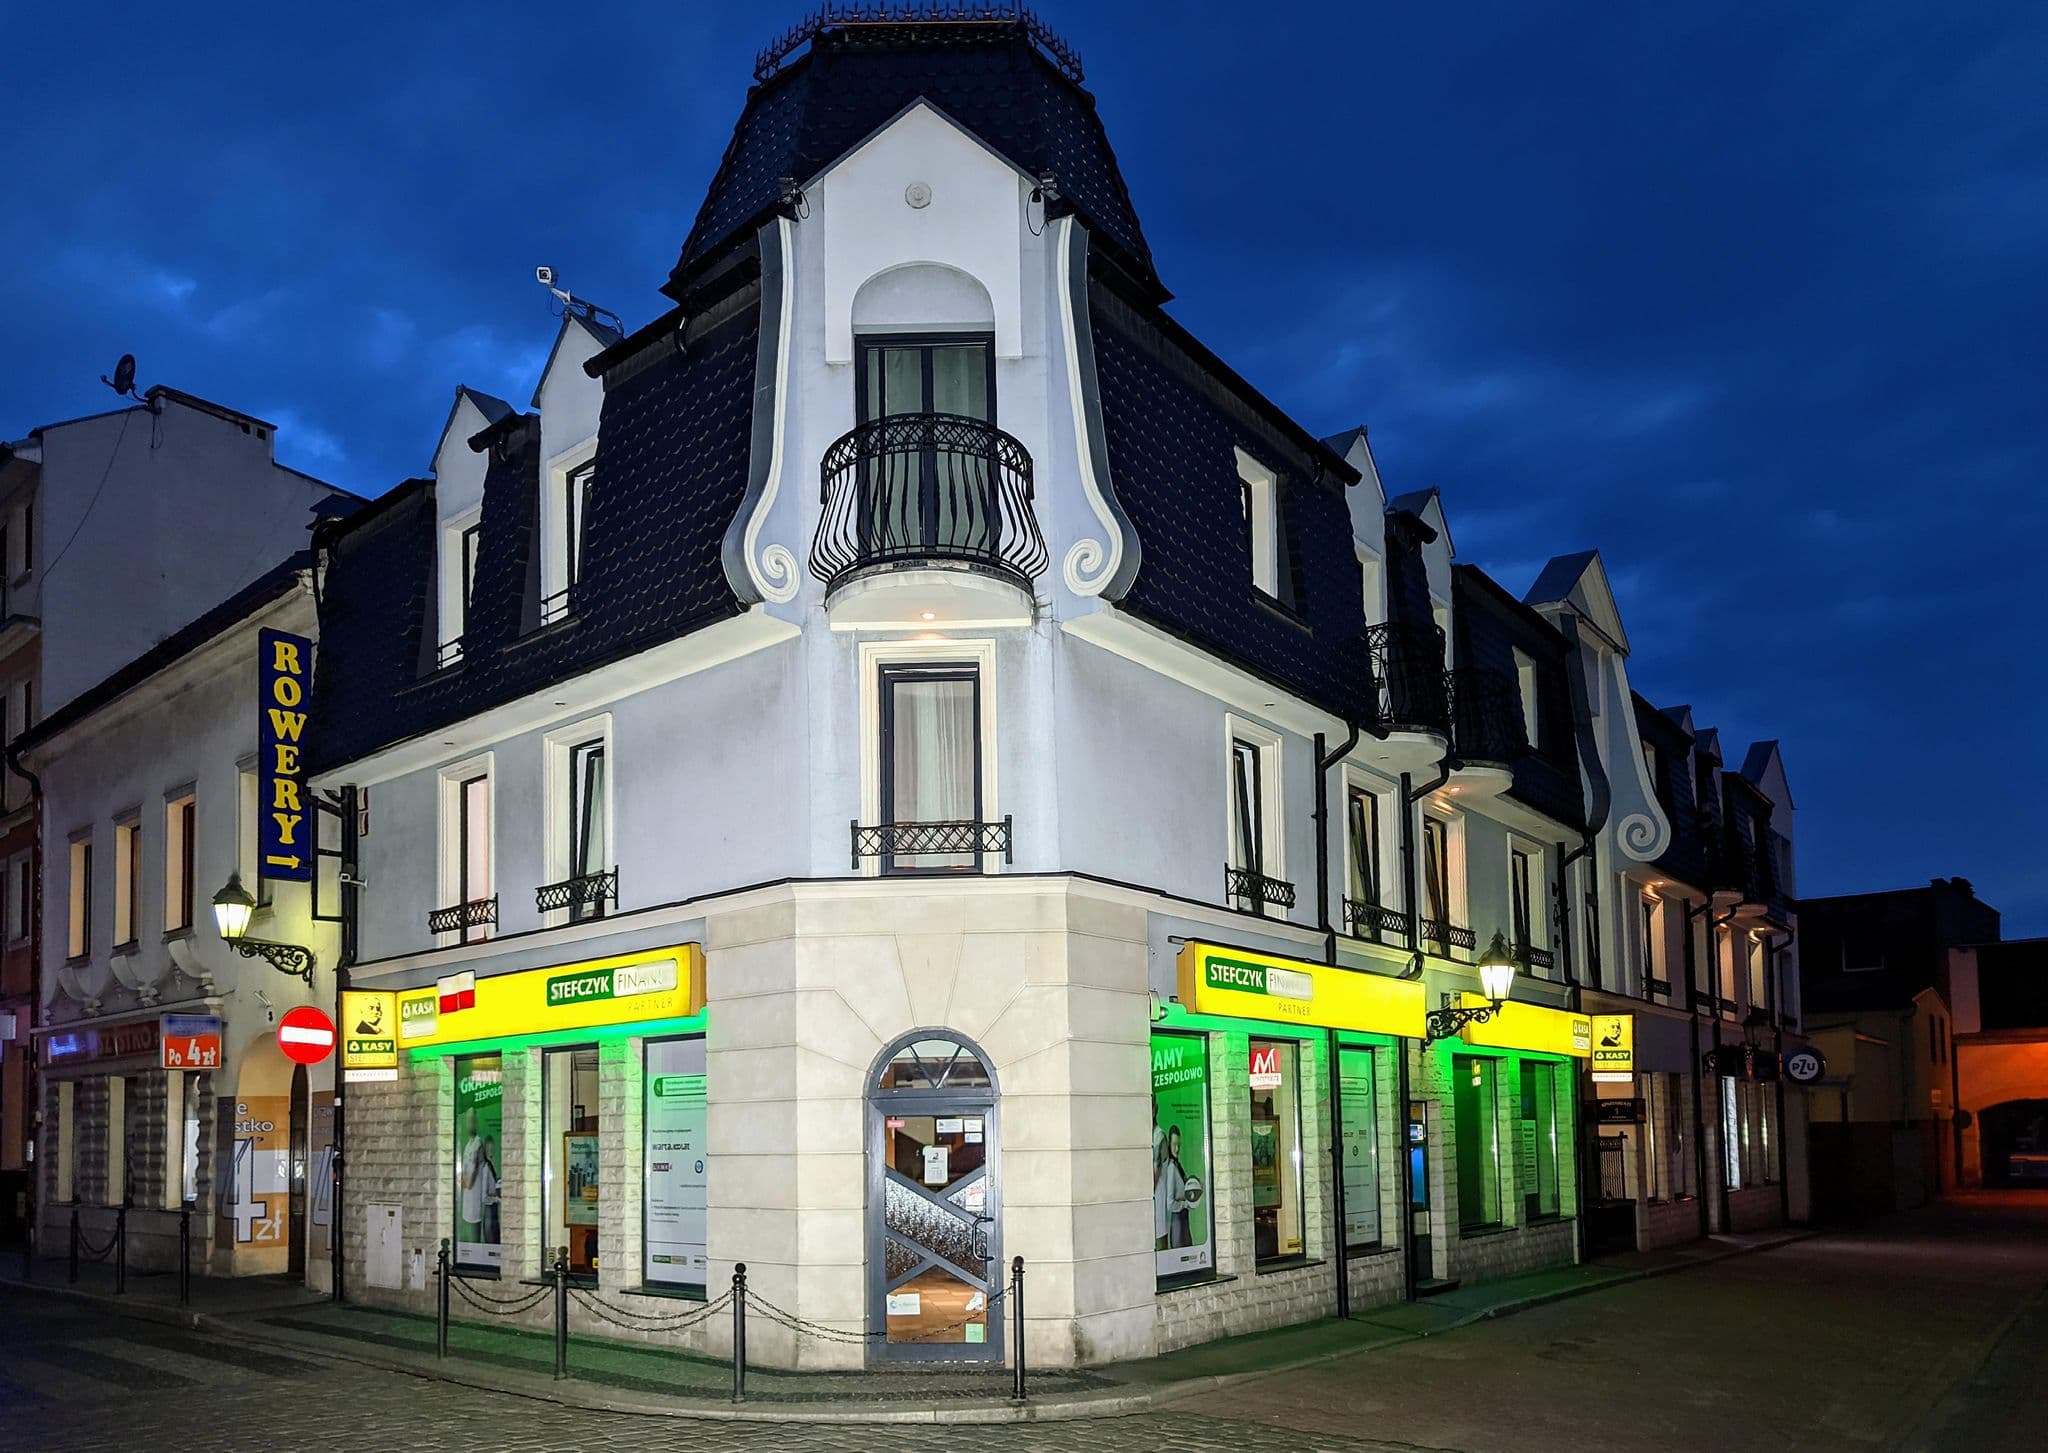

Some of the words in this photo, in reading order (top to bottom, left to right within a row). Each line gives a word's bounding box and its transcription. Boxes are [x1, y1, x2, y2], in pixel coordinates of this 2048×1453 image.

[268, 640, 307, 845] ROWERY
[1210, 963, 1264, 988] STEFCZYK
[551, 976, 610, 1001] STEFCZYK
[411, 1001, 435, 1017] KASA
[626, 997, 673, 1011] PARTNER
[1278, 1002, 1312, 1017] PARTNER
[168, 1048, 182, 1066] Po
[187, 1038, 201, 1066] 4
[202, 1047, 217, 1066] zł
[362, 1041, 392, 1052] KASY
[1606, 1052, 1630, 1060] KASY
[1151, 1047, 1184, 1072] AMY
[1792, 1058, 1816, 1075] PZU
[1154, 1066, 1203, 1088] ZESPOŁOWO
[222, 1136, 267, 1243] 4
[256, 1209, 282, 1241] zł
